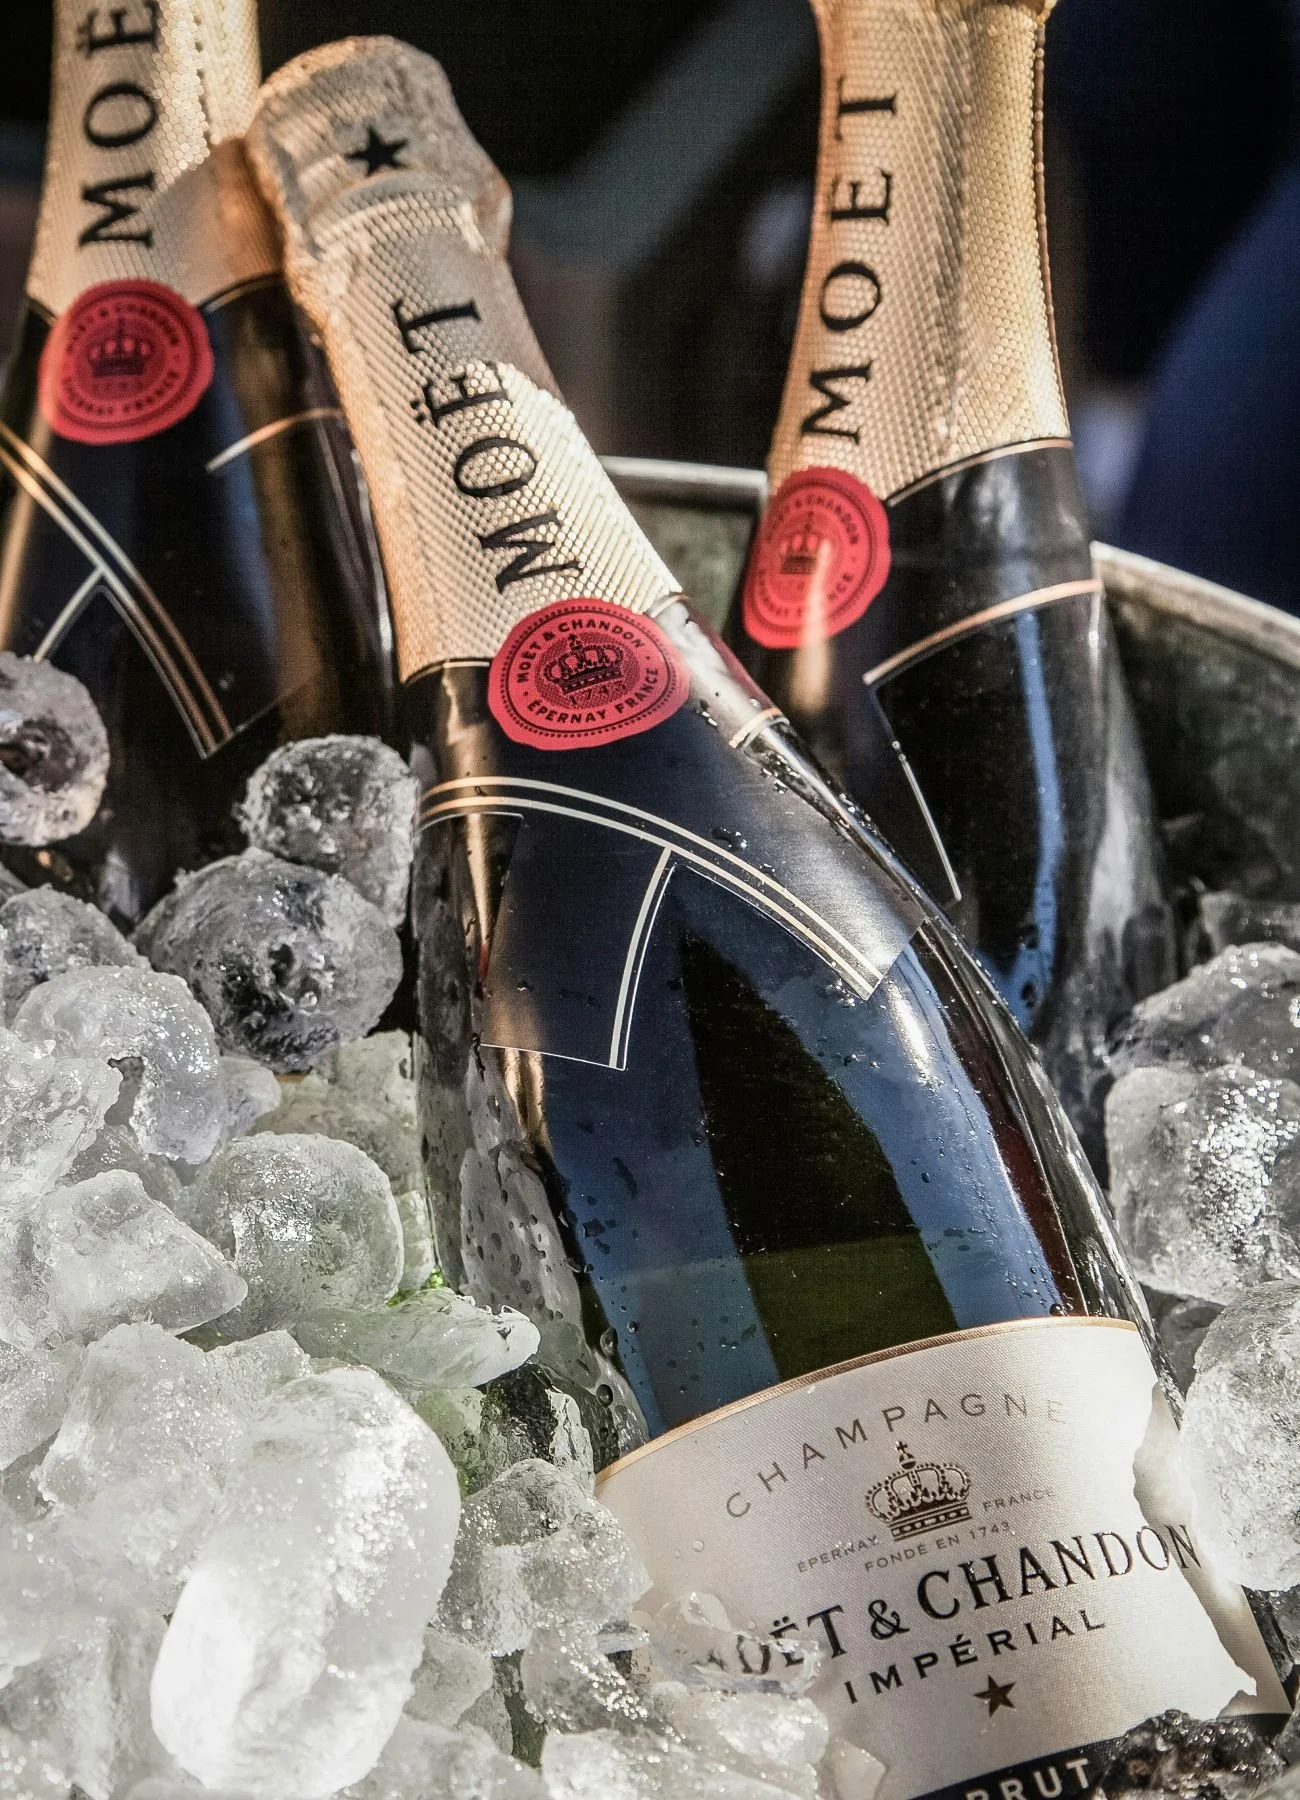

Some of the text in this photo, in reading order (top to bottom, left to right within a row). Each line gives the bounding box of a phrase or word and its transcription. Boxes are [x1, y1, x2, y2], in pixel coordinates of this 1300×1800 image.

[392, 300, 583, 594] MOËT
[542, 630, 555, 642] &
[558, 618, 645, 649] CHANDON
[615, 667, 659, 714] FRANCE
[726, 1393, 1067, 1519] CHAMPAGNE
[983, 1488, 1056, 1512] FRANCE
[864, 1521, 1010, 1573] FONDÉ EN 1743
[688, 1524, 1202, 1676] OËT & CHANDON
[844, 1609, 1106, 1704] IMPÉRIAL
